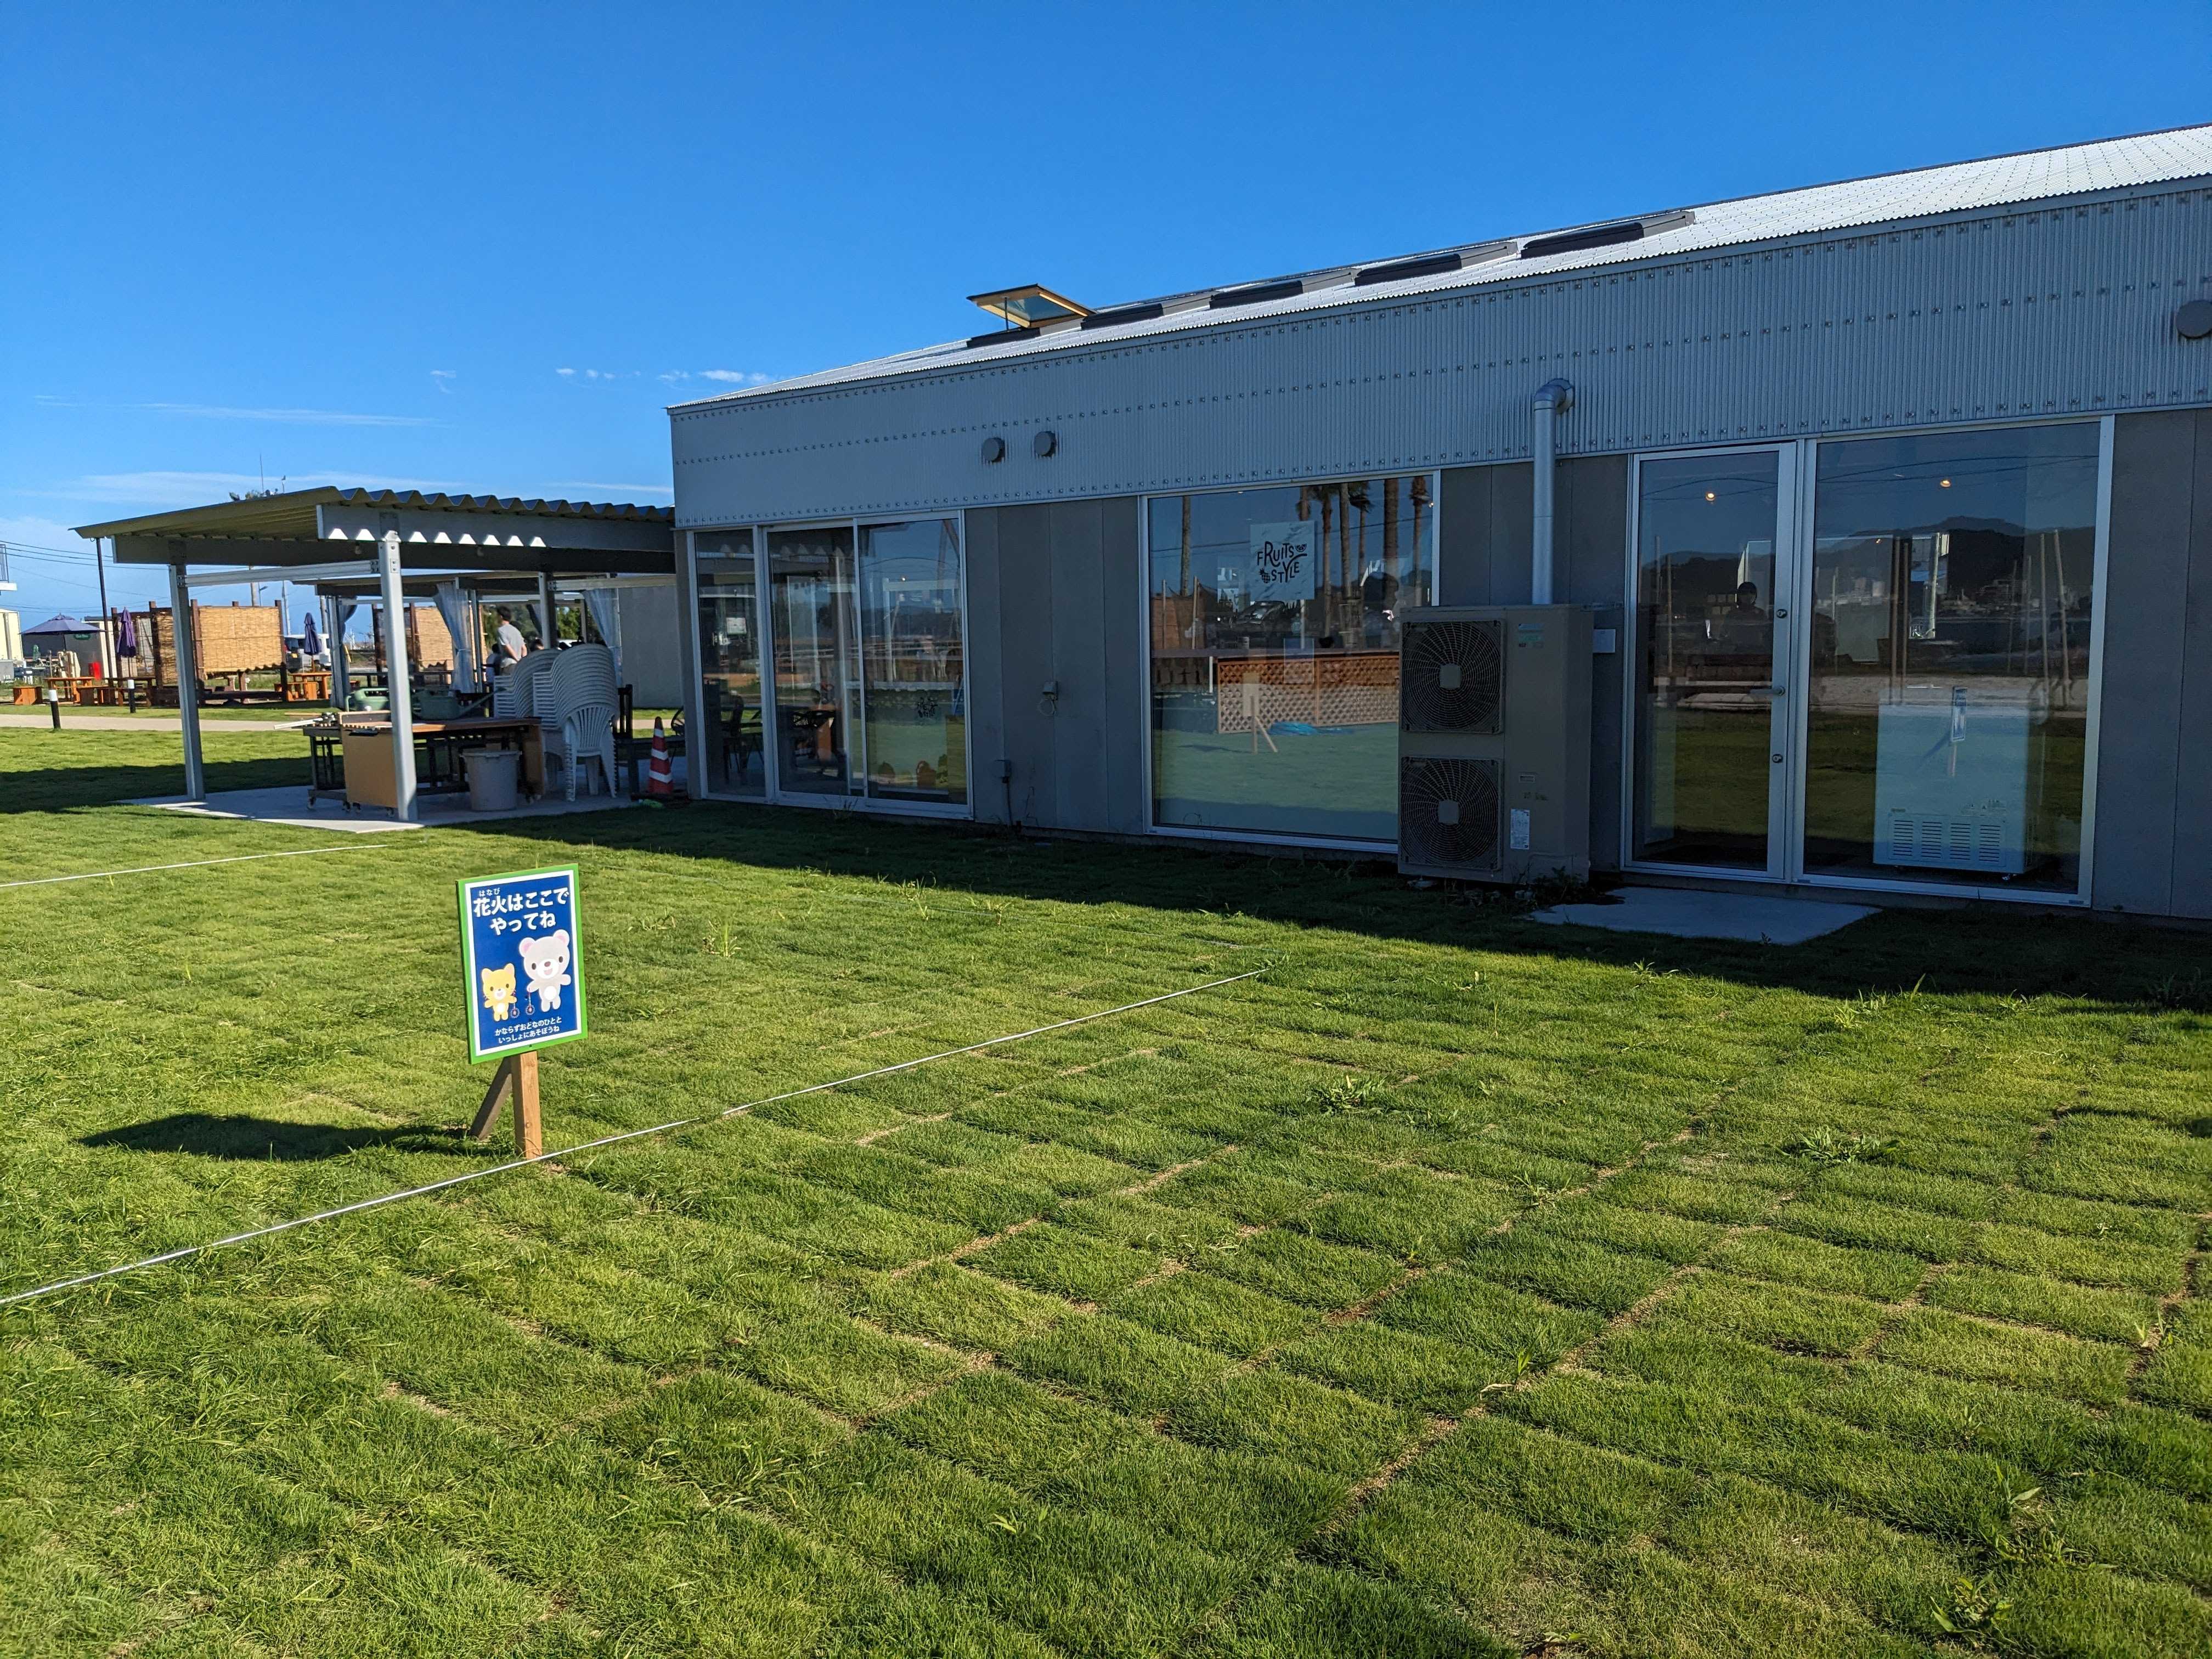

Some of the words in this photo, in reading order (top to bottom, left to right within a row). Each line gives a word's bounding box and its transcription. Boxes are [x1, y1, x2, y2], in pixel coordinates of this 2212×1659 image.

[1257, 541, 1294, 567] FRUITS
[1271, 554, 1307, 583] STYLE
[473, 887, 569, 917] 花火はここで
[479, 888, 500, 897] はなび
[490, 911, 556, 935] やってね
[499, 1025, 560, 1043] いっしょにあそぼうね
